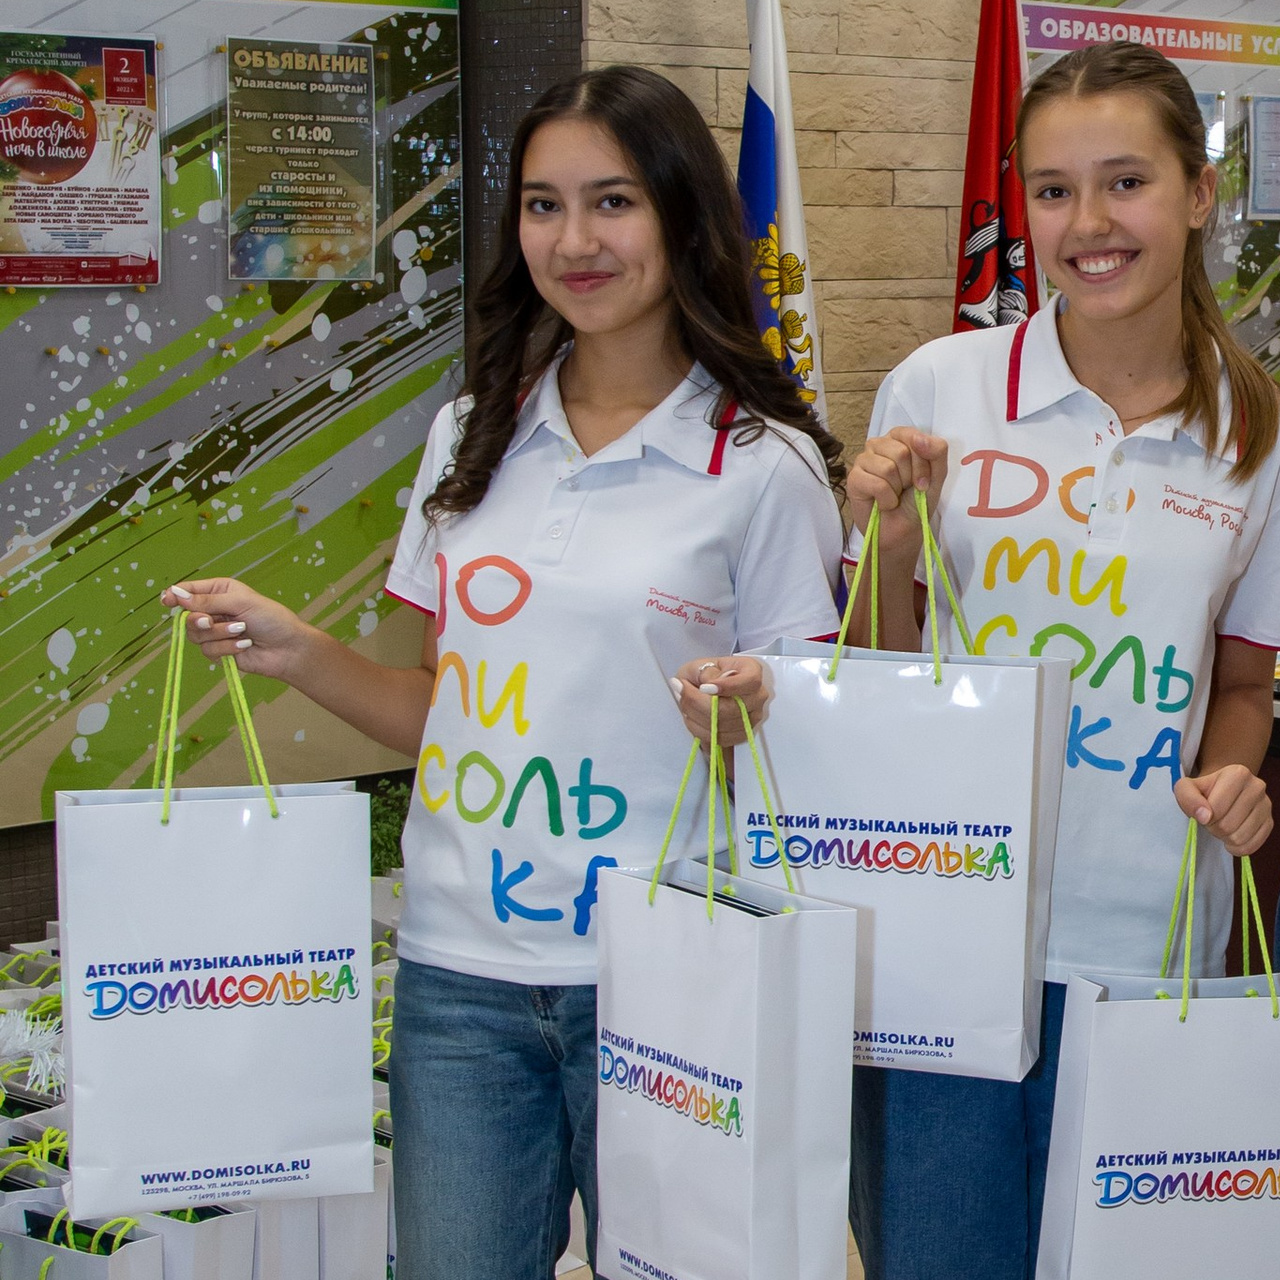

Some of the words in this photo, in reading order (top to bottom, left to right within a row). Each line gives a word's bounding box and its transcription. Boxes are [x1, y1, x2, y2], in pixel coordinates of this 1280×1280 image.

[1040, 18, 1242, 52] ОБРАЗОВАТЕЛЬНЫЕ
[119, 57, 130, 73] 2
[234, 49, 368, 74] ОБЪЯВЛЕНИЕ
[235, 76, 307, 91] Уважаемые
[310, 83, 367, 94] родители!
[242, 110, 270, 120] групп,
[273, 113, 313, 122] которые
[316, 115, 369, 124] занимаются
[287, 125, 335, 144] 14:00,
[5, 143, 35, 157] ночь
[48, 145, 88, 159] школе
[246, 145, 273, 154] через
[275, 147, 316, 155] турникет
[318, 148, 359, 157] проходят
[288, 160, 319, 168] только
[271, 172, 326, 182] старосты
[276, 185, 347, 197] помощники,
[266, 200, 324, 208] зависимости
[338, 202, 360, 210] того,
[284, 213, 334, 221] школьники
[250, 226, 289, 234] старшие
[291, 226, 354, 235] дошкольники.
[983, 536, 1128, 617] МИ
[435, 552, 532, 637] О
[1066, 704, 1182, 791] КА
[418, 744, 627, 839] СОЛЬ
[825, 817, 958, 836] МУЗЫКАЛЬНЫЙ
[963, 824, 1012, 838] ТЕАТР
[747, 830, 1010, 877] ДОМИСОЛЬКА
[86, 958, 164, 978] ДЕТСКИЙ
[169, 949, 303, 972] МУЗЫКАЛЬНЫЙ
[308, 948, 355, 962] ТЕАТР
[86, 964, 355, 1016] ДОМИСОЛЬКА
[601, 1027, 634, 1053] ДЕТСКИЙ
[636, 1043, 708, 1082] МУЗЫКАЛЬНЫЙ
[711, 1072, 743, 1093] ТЕАТР
[904, 1049, 946, 1058] БИРЮЗОВА,
[600, 1045, 741, 1132] ДОМИСОЛЬКА
[1096, 1151, 1168, 1168] ДЕТСКИЙ
[141, 1159, 310, 1185] WWW.DOMISOLKA.RU
[172, 1183, 205, 1192] МОСКВА,
[220, 1178, 260, 1188] МАРШАЛА
[261, 1175, 304, 1184] БИРЮЗОВА,
